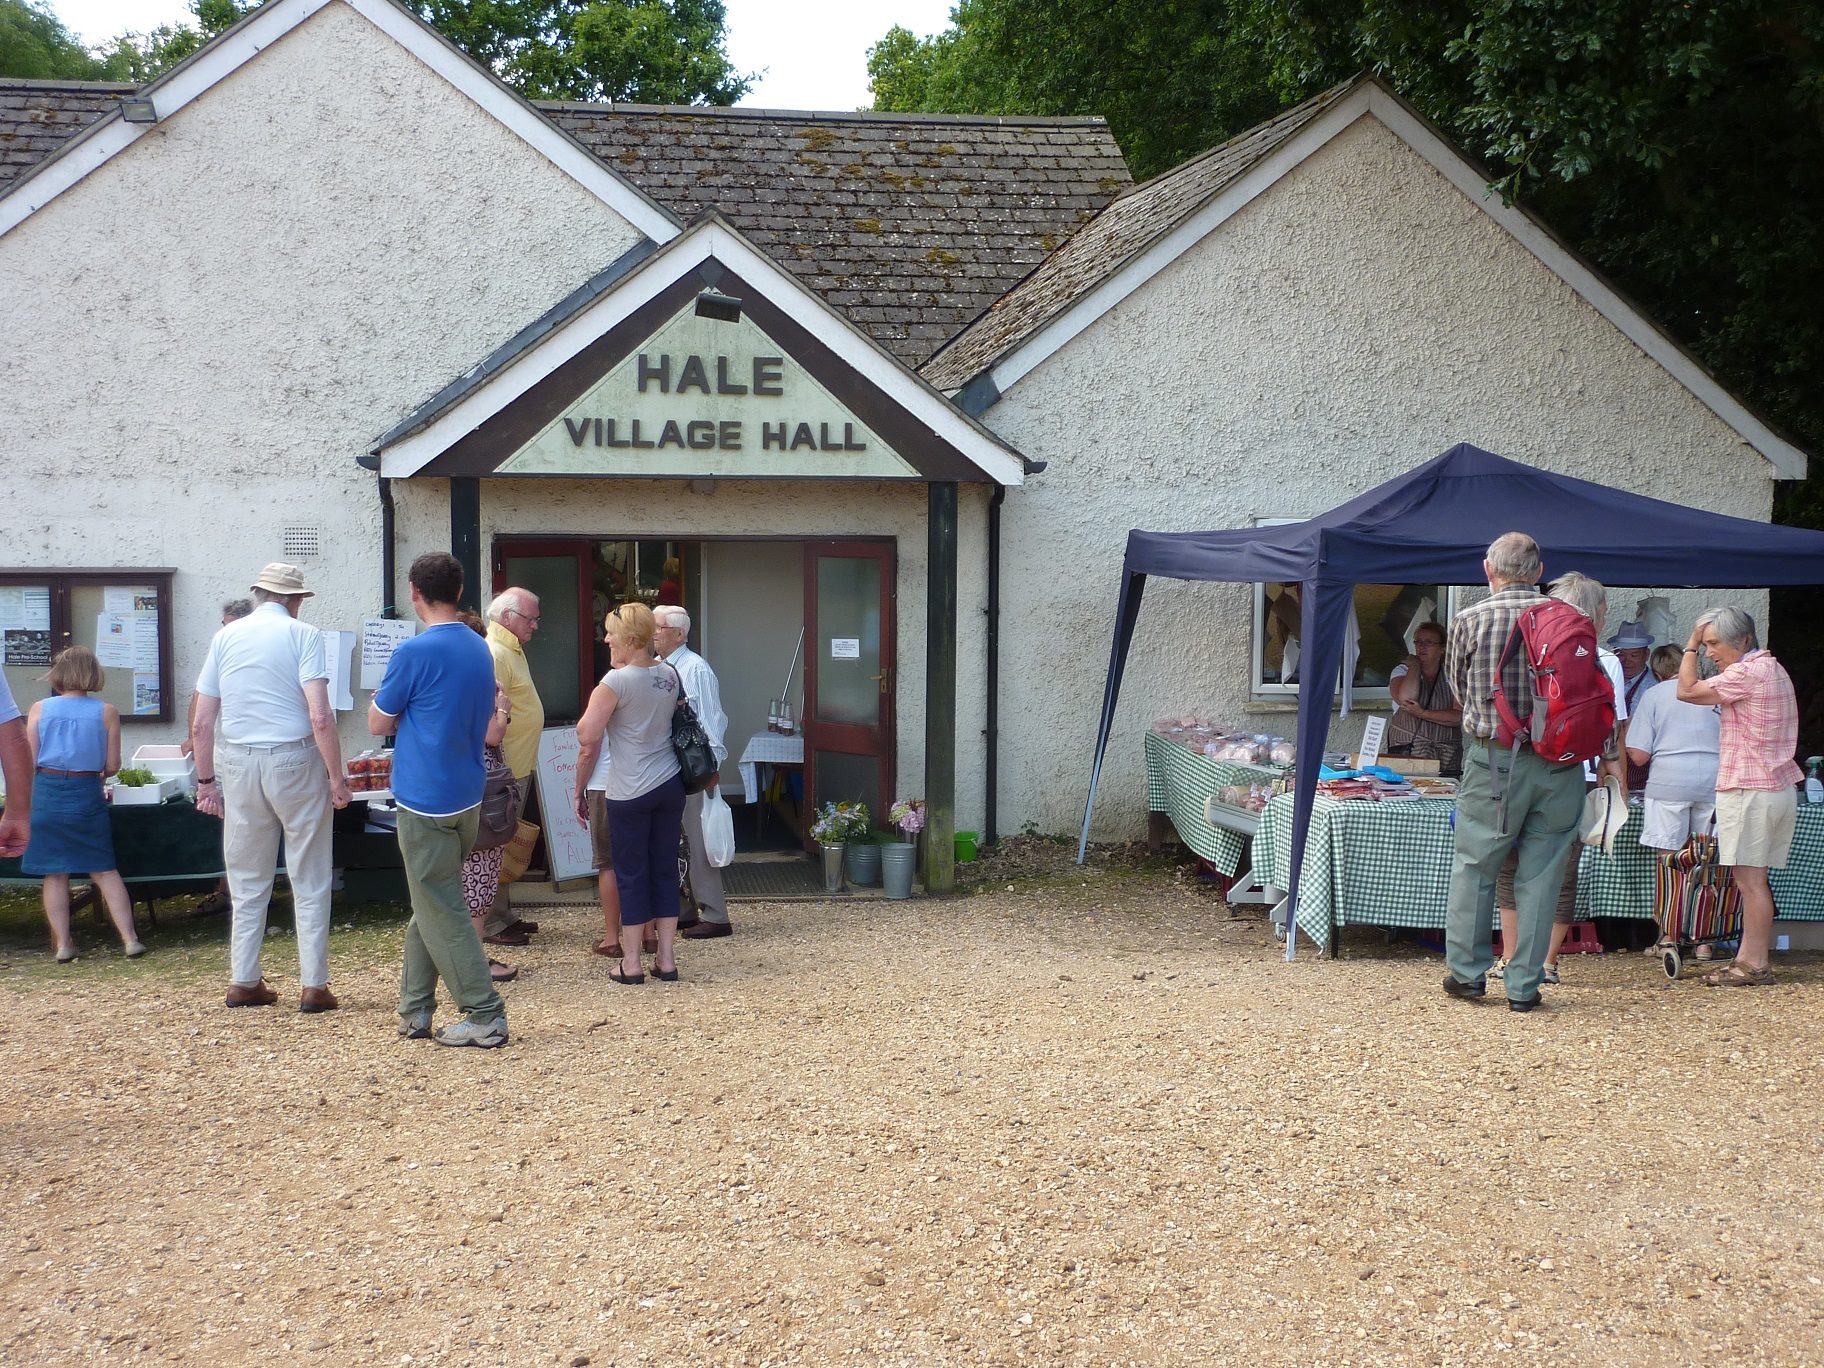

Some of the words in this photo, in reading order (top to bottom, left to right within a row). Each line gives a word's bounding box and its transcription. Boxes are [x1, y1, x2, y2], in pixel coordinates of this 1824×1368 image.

[637, 353, 783, 396] HALE
[563, 416, 742, 450] VILLAGE
[762, 420, 867, 451] HALL
